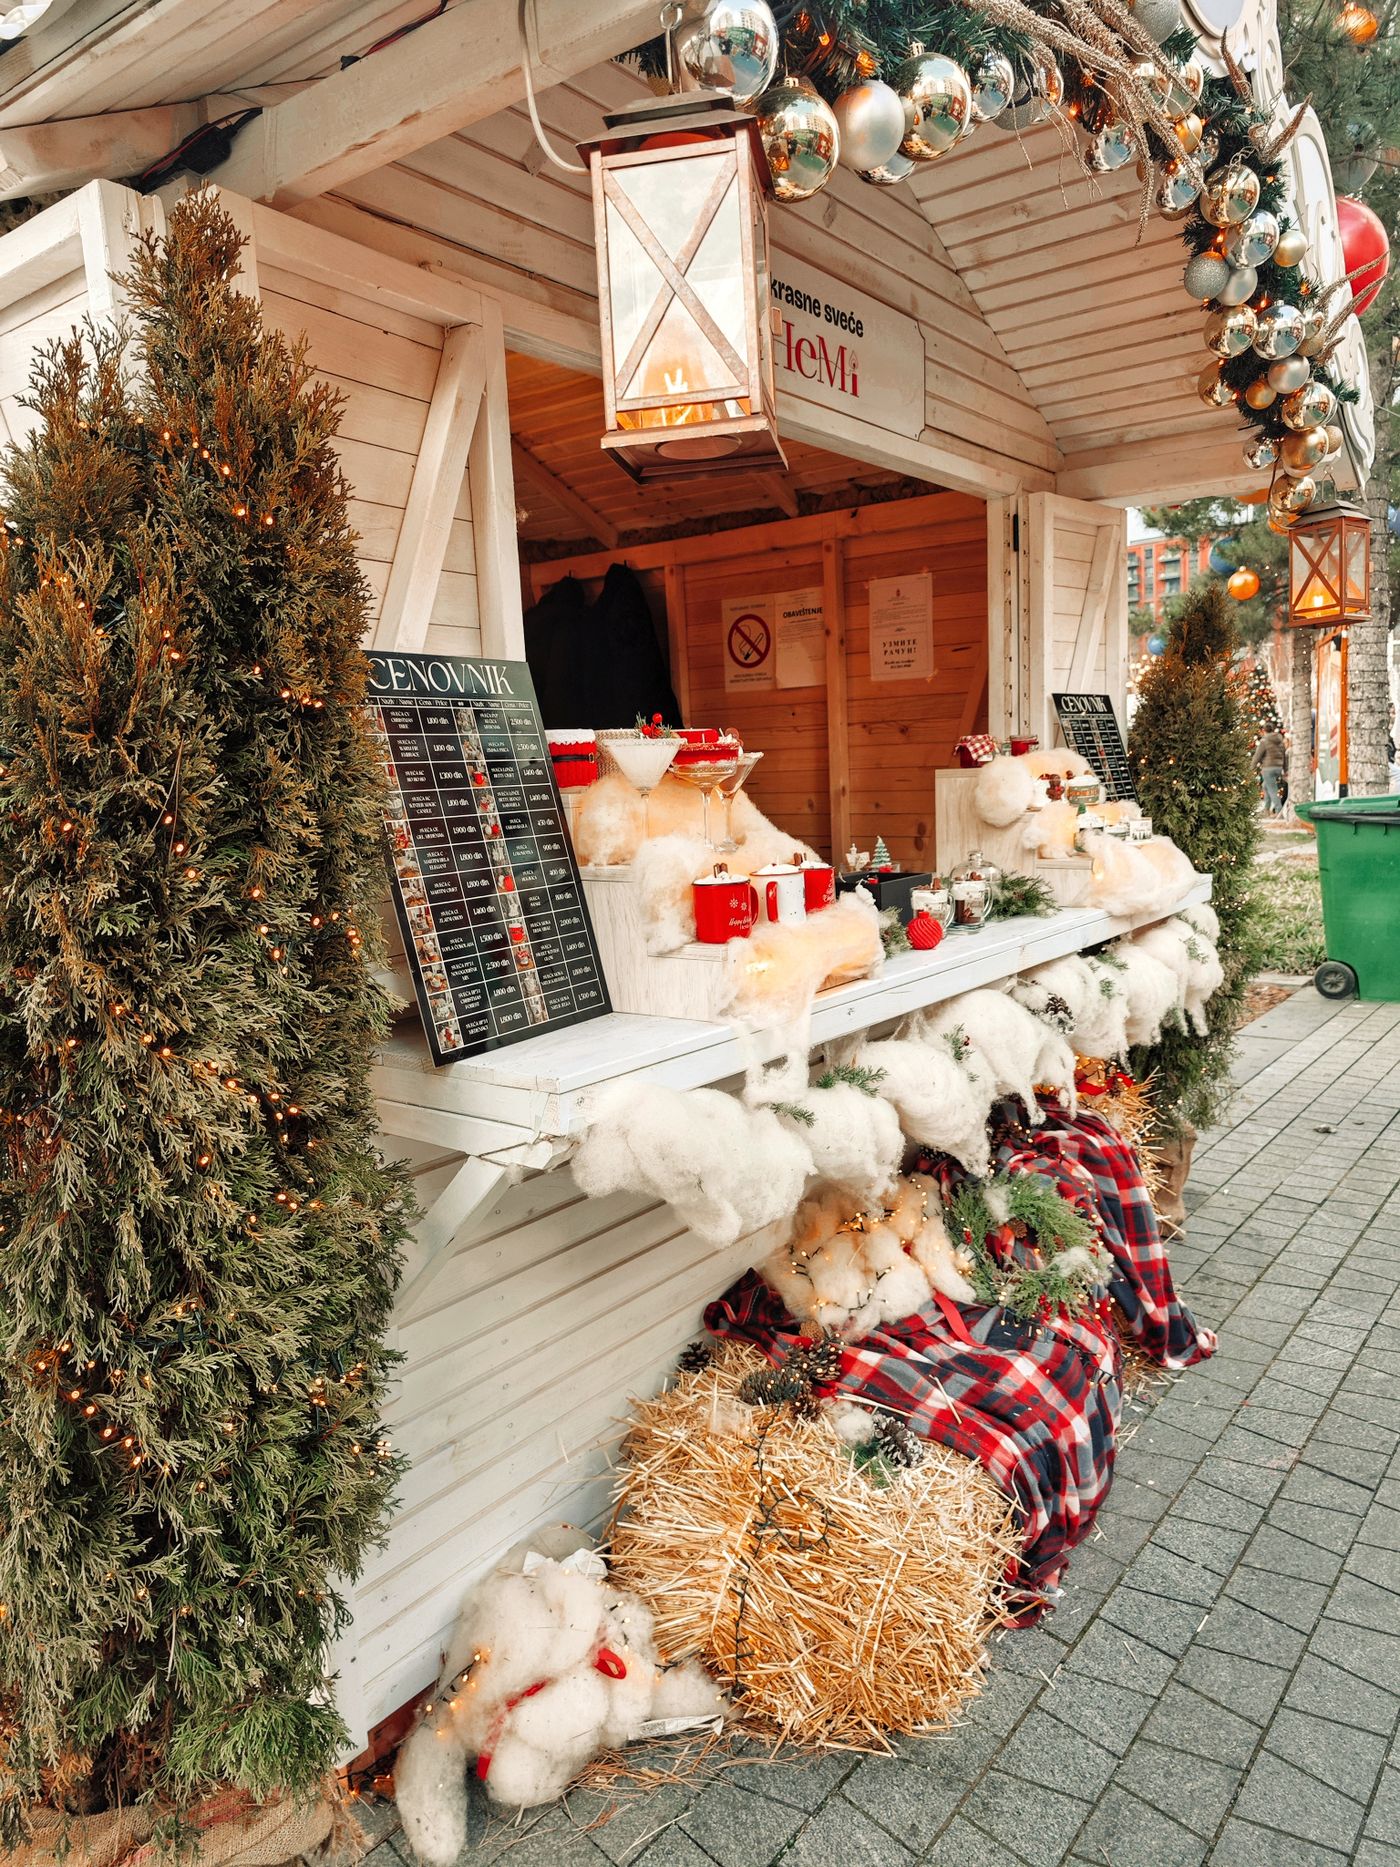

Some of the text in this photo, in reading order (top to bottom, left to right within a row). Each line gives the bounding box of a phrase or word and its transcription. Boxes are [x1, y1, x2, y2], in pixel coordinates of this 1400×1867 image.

[824, 303, 864, 338] sveće
[783, 607, 823, 618] OBAVEŠTENJE
[368, 658, 514, 695] CENOVNIK
[1061, 696, 1107, 713] CENOVNIK
